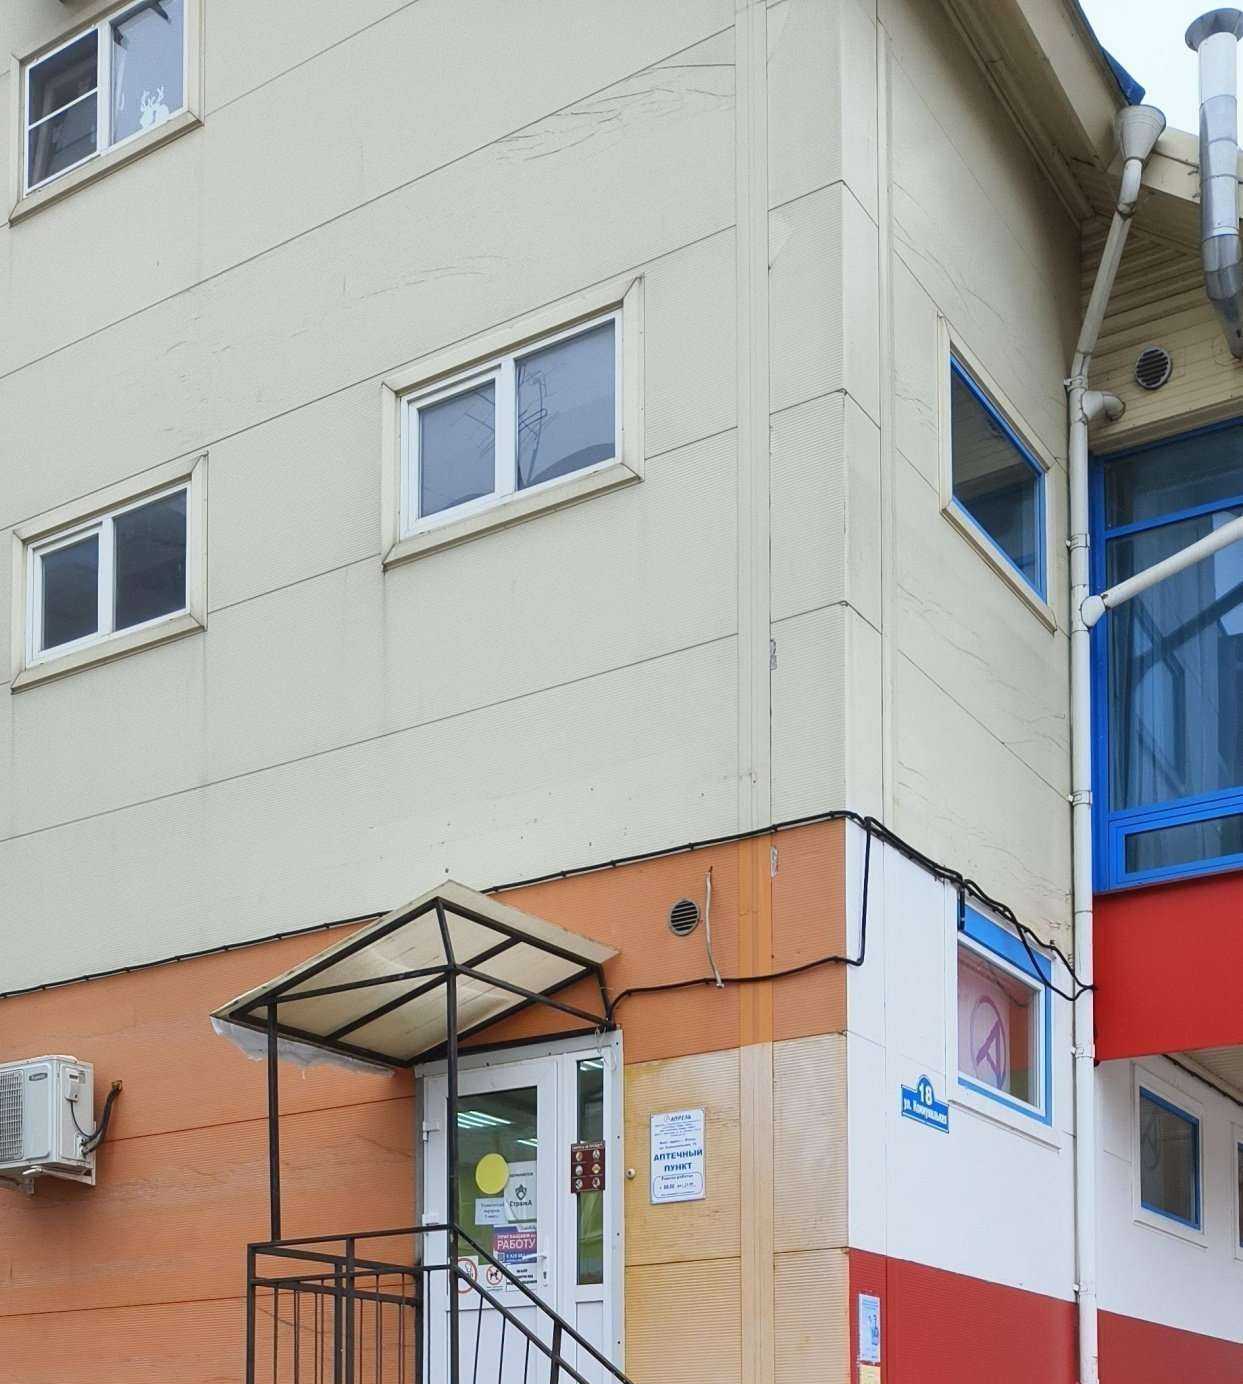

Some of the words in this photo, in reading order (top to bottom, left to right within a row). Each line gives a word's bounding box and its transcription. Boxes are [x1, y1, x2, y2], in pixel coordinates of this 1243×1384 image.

[920, 1083, 933, 1106] 18
[654, 1149, 703, 1161] АПТЕЧНЫЙ
[664, 1162, 692, 1173] ПУНКТ
[497, 1239, 536, 1250] РАБОТУ
